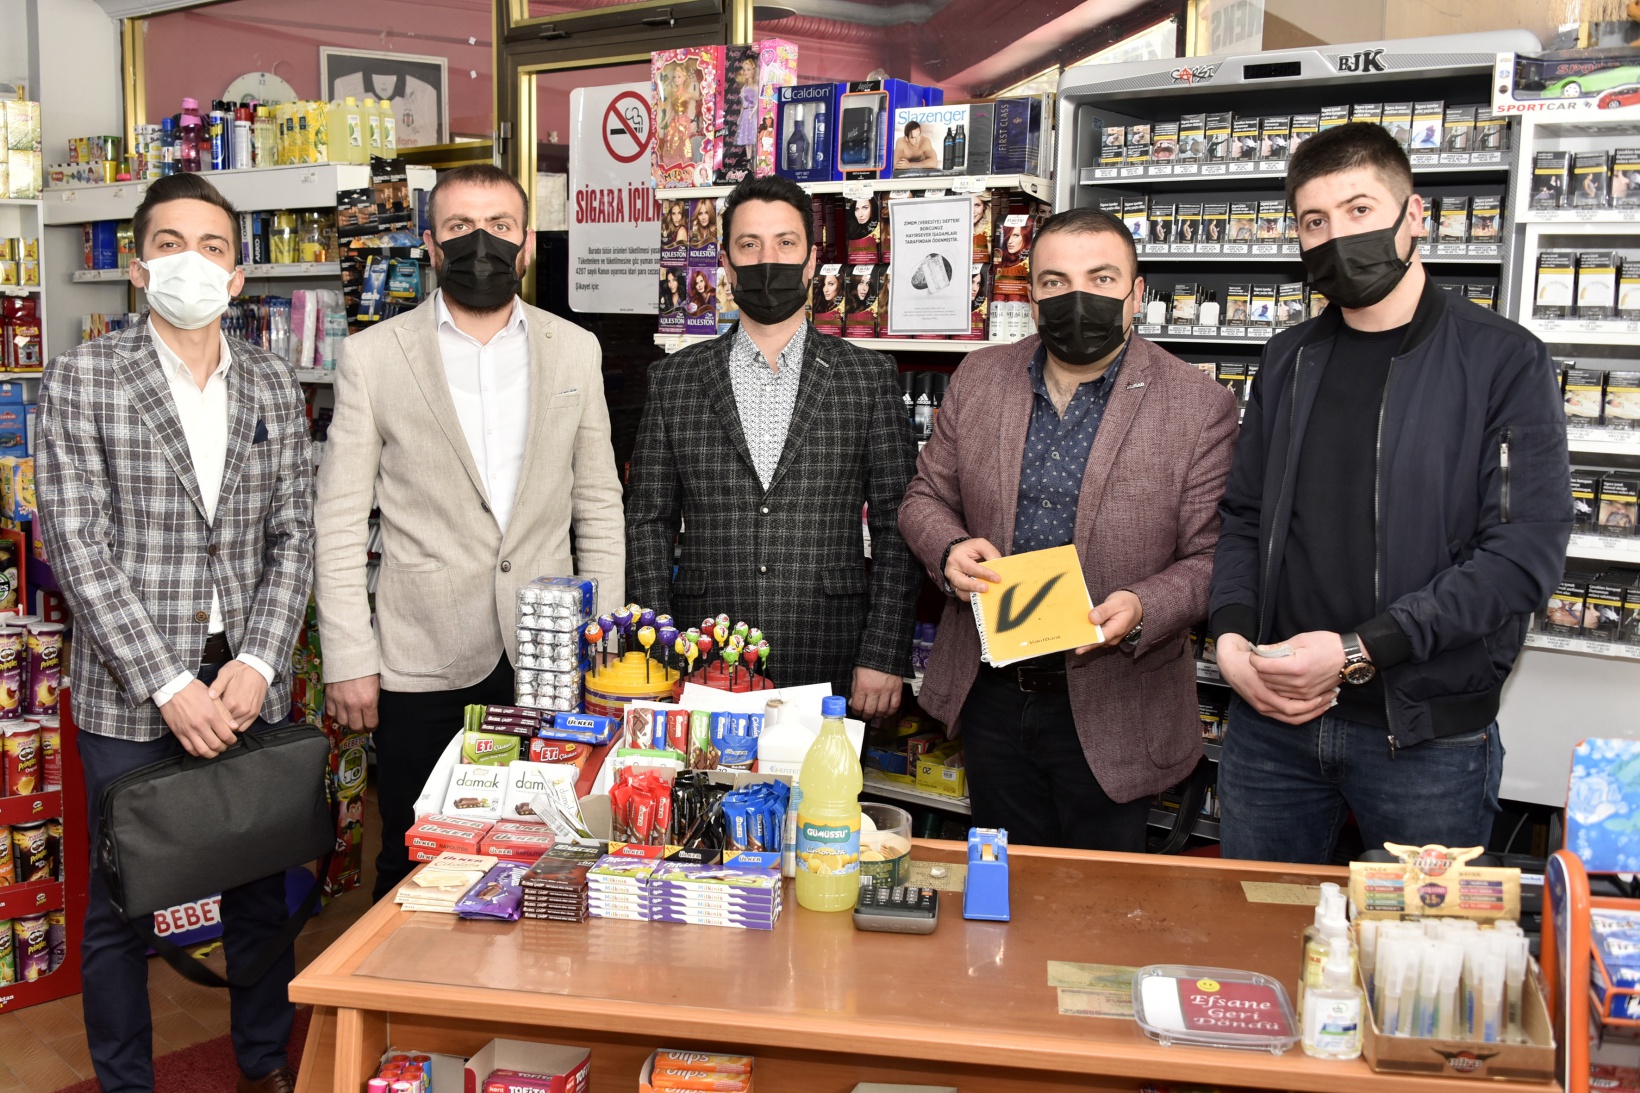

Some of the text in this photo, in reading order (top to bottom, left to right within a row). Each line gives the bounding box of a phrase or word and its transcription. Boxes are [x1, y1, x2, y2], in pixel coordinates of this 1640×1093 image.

[1338, 48, 1387, 73] BJK
[792, 87, 829, 99] caldion
[1497, 102, 1577, 112] SPORTCAR
[898, 109, 966, 126] Slazenger
[999, 130, 1007, 153] FIRST
[576, 184, 625, 224] SİGARA
[40, 658, 59, 670] Pringles
[567, 717, 594, 728] ÜLKER
[343, 736, 366, 750] BEBETO
[18, 758, 37, 772] Pringles
[923, 766, 931, 774] 20
[456, 772, 499, 788] damak
[516, 772, 546, 790] dam
[429, 814, 483, 828] ÜLKER
[419, 824, 474, 838] ÜLKER
[413, 838, 436, 848] ÜLKER
[493, 833, 550, 843] ÜLKER
[489, 847, 512, 855] ÜLKER
[623, 847, 644, 855] ÜLKER
[679, 851, 701, 859] ÜLKER
[30, 850, 47, 865] Pringles
[443, 855, 483, 863] ÜLKER
[603, 876, 626, 884] Milkinis
[605, 885, 629, 893] Milkinis
[28, 942, 47, 955] Pringles
[1190, 994, 1272, 1010] Efsane
[1208, 1008, 1259, 1020] Geri
[1194, 1017, 1280, 1030] Döndü
